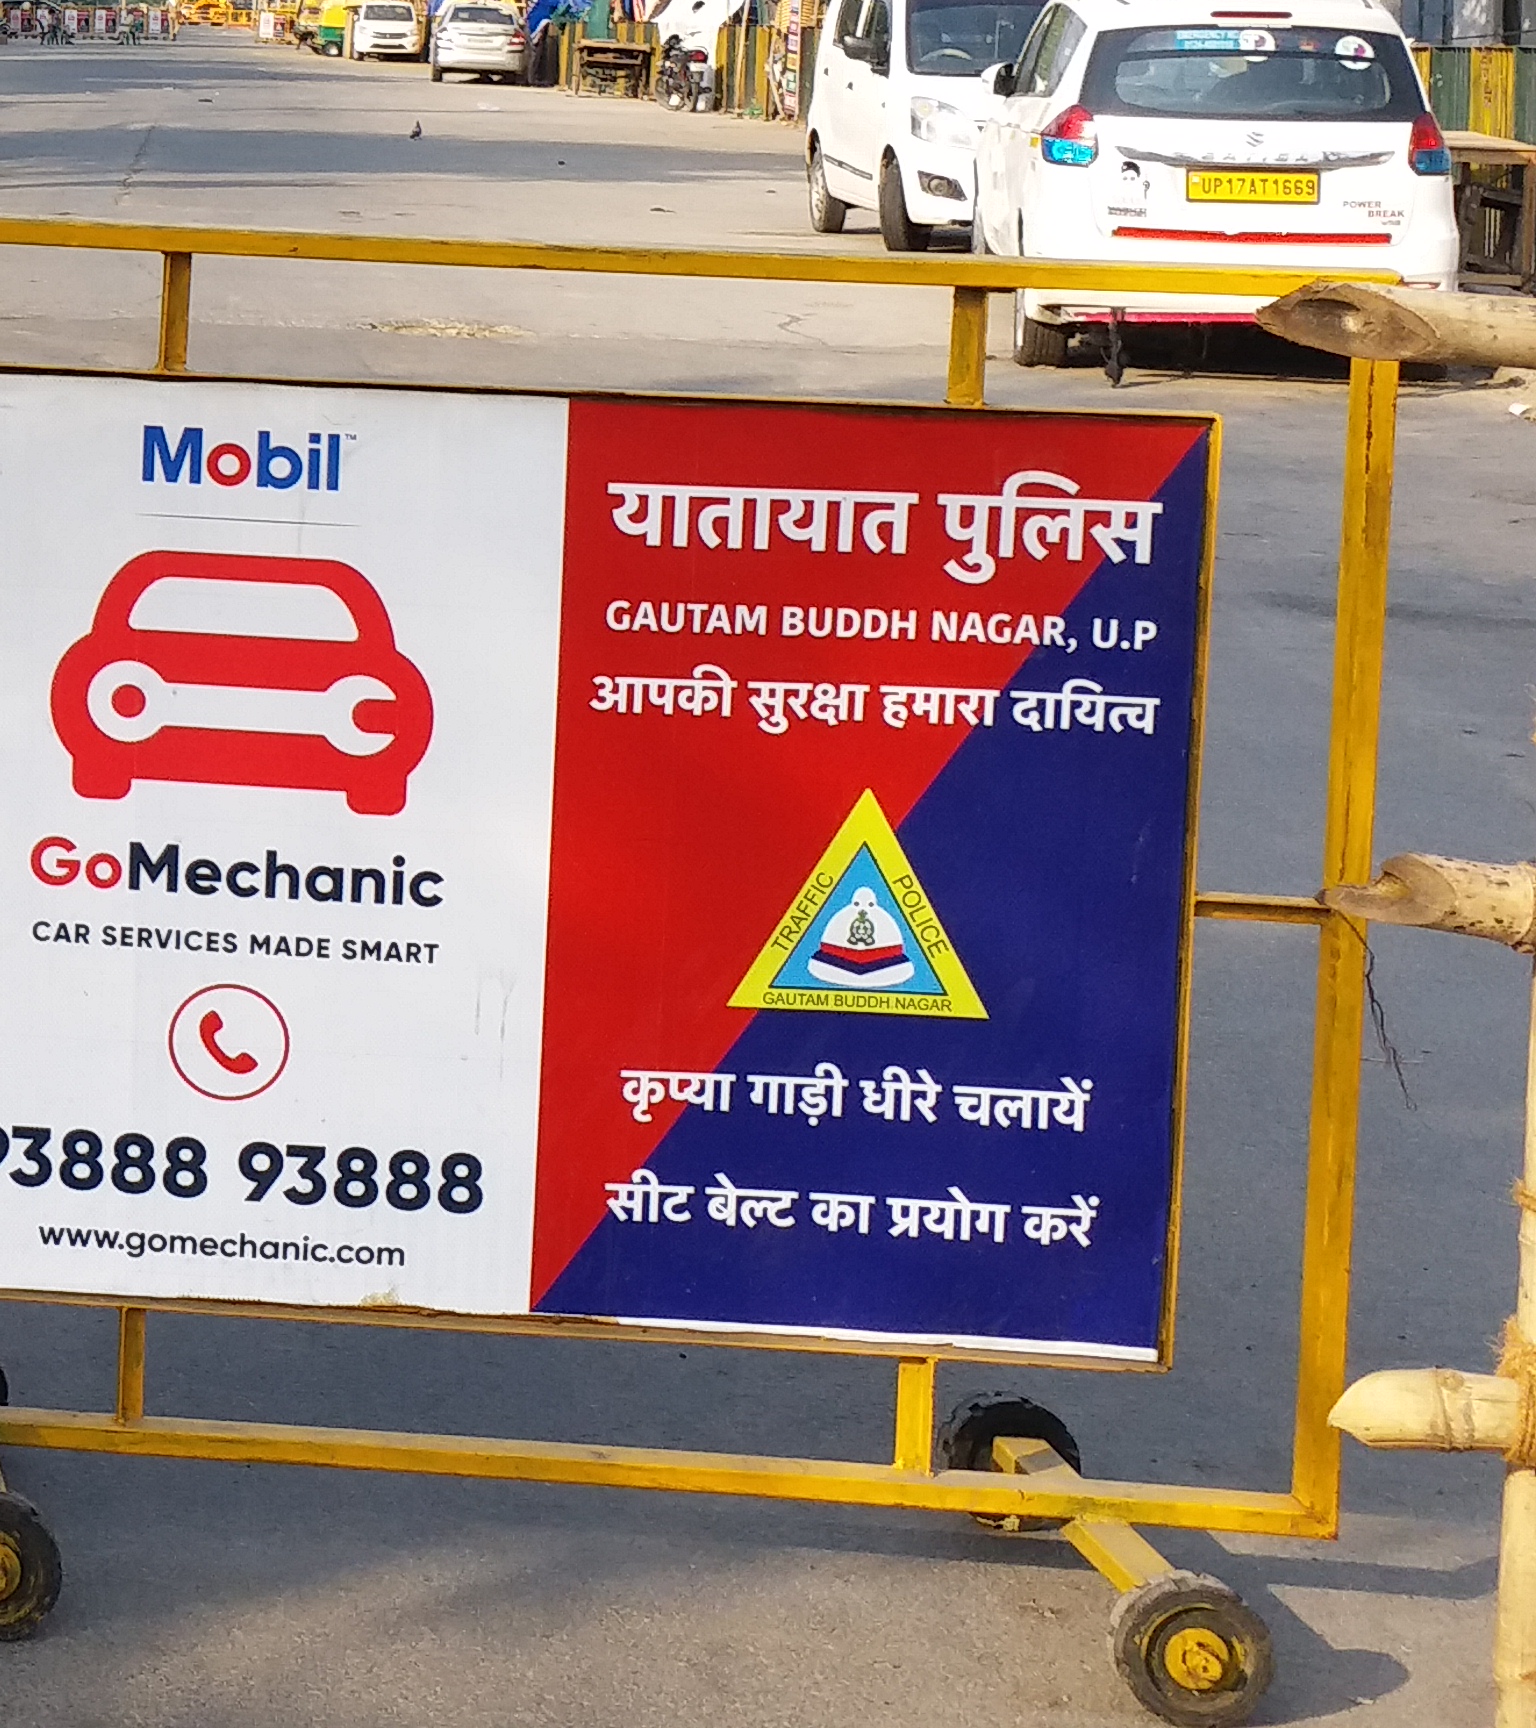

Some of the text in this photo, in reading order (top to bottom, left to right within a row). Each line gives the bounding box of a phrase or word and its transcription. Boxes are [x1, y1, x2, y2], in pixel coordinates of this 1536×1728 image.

[1201, 177, 1316, 196] UP17AT1669
[1343, 200, 1382, 209] POWER
[1368, 210, 1405, 218] BREAK
[141, 424, 341, 492] Mobil
[607, 470, 1163, 585] यातायात पुलिस
[606, 599, 1158, 654] GAUTAM BUDDH NAGAR, U.P
[589, 664, 1160, 736] आपकी सुरक्षा हमारा दायित्व
[30, 835, 445, 908] GoMechanic
[31, 920, 440, 964] CAR SERVICES MADE SMART
[770, 872, 834, 952] TRAFFIC
[892, 874, 950, 959] POLICE
[762, 991, 953, 1012] GAUTAM BUDDH NAGAR
[621, 1062, 1093, 1131] कृप्या गाड़ी धीरे चलायें
[238, 1141, 484, 1214] 93888
[605, 1168, 1099, 1248] सीट बेल्ट का प्रयोग करें
[38, 1225, 406, 1267] www.gomechanic.com
